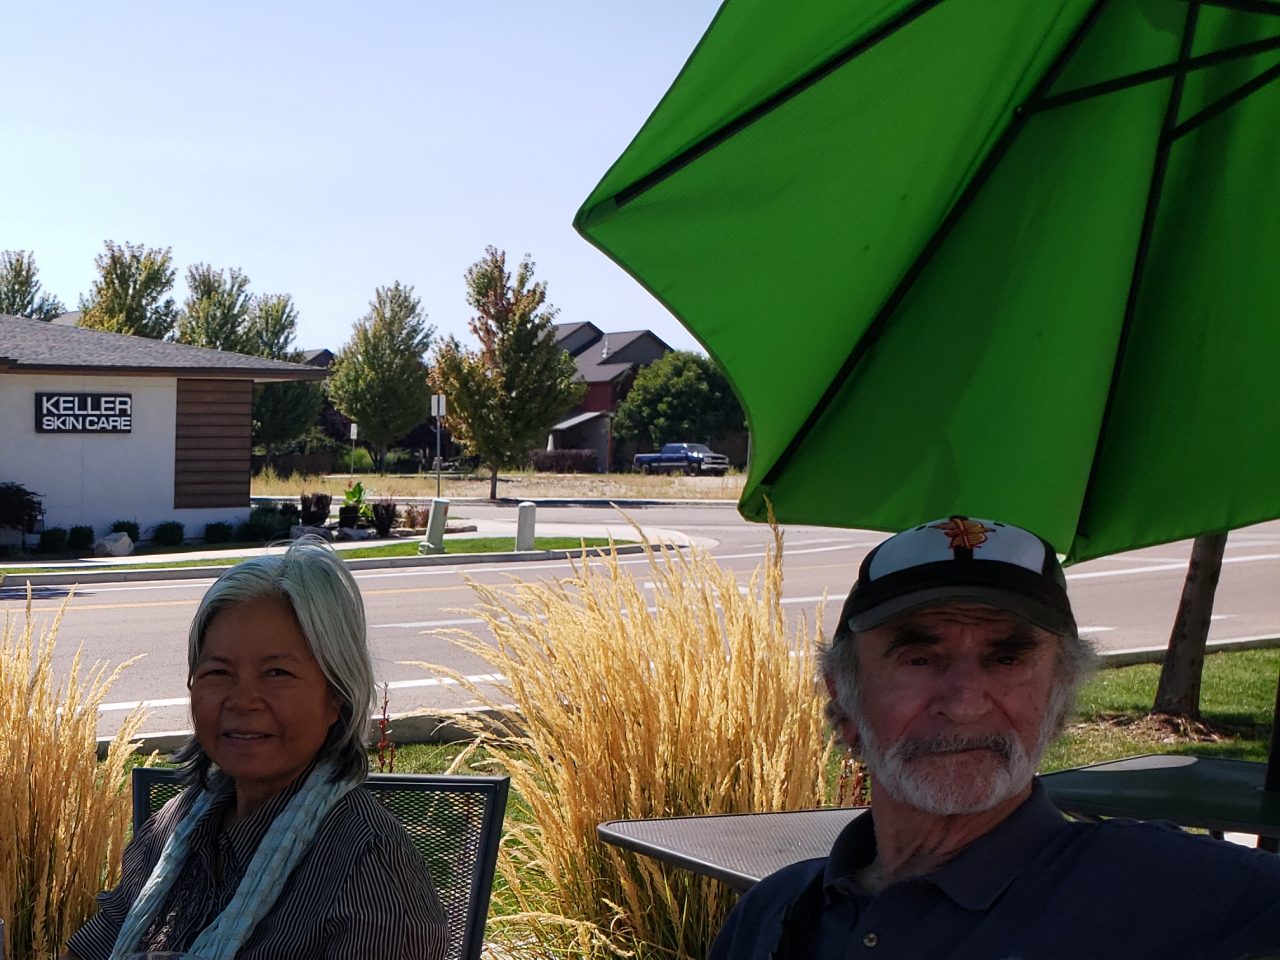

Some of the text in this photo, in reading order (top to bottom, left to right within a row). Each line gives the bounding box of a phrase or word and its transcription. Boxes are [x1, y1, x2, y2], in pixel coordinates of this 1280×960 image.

[42, 396, 131, 415] KELLER
[42, 416, 131, 430] SKIN CARE
